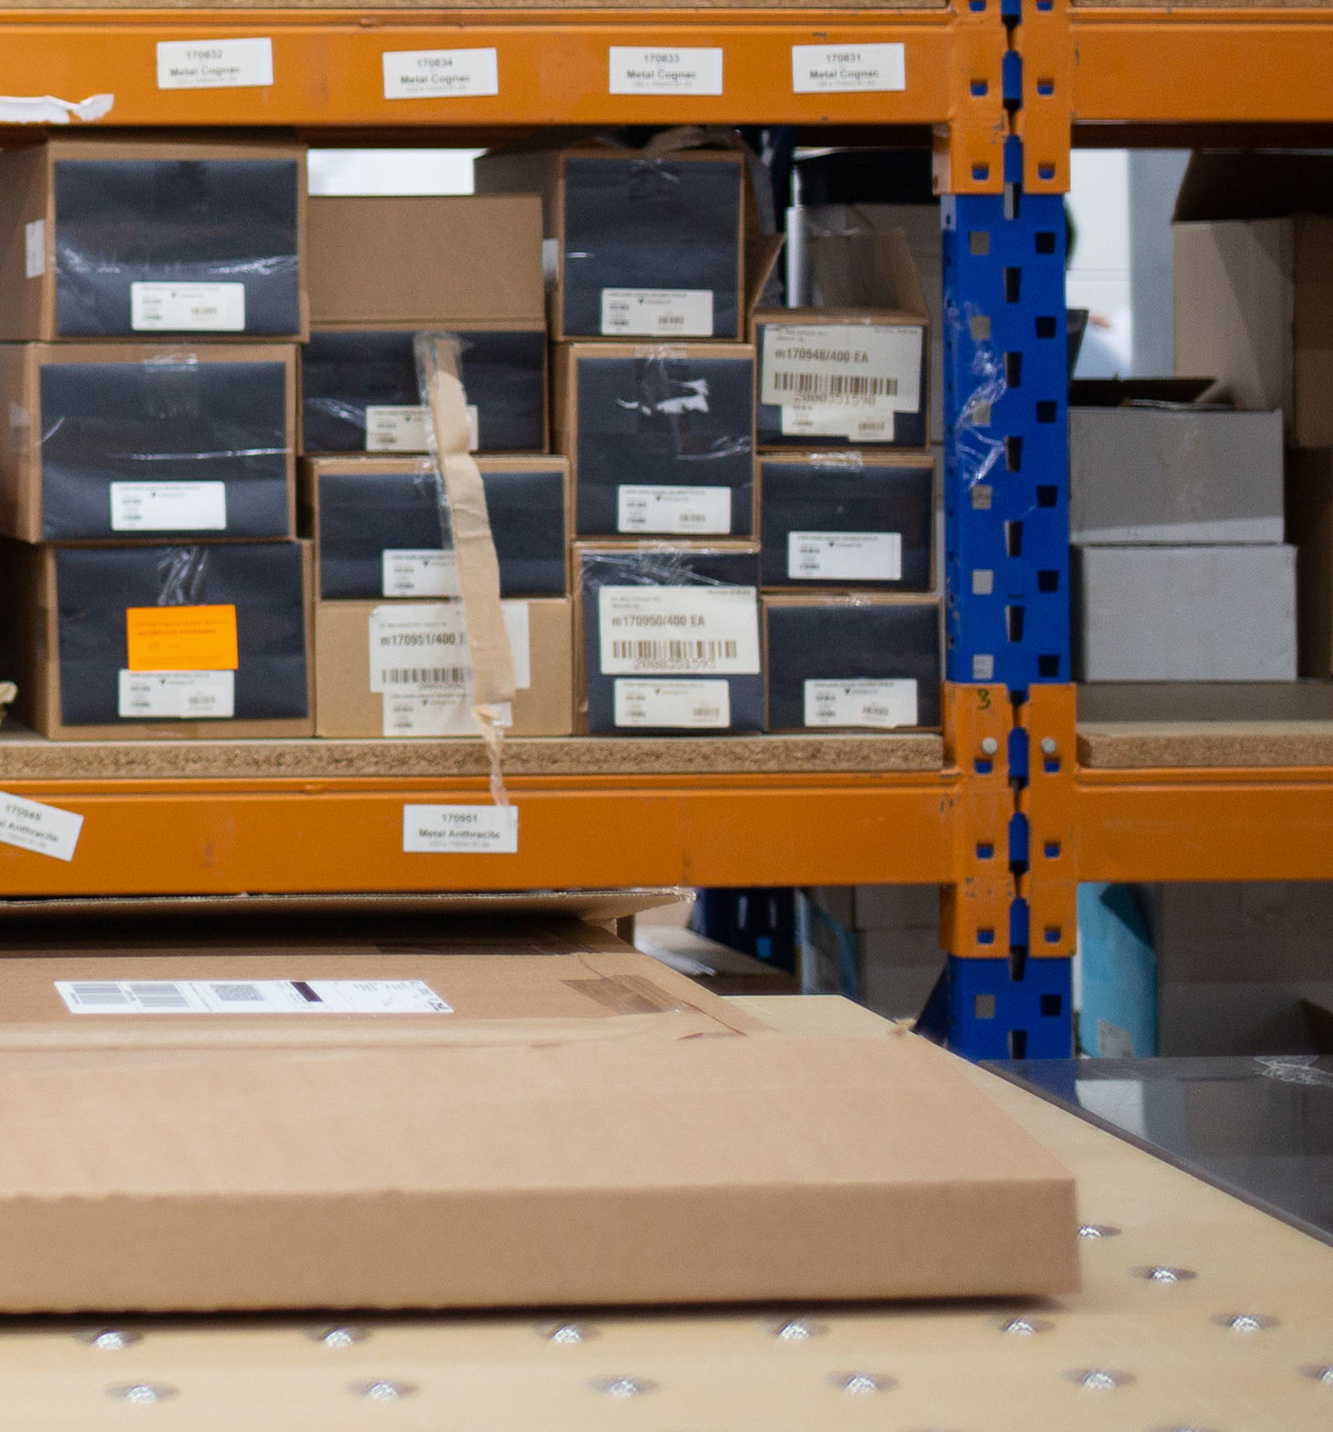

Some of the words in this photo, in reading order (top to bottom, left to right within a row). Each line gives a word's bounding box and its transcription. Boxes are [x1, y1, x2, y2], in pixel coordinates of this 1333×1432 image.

[169, 67, 199, 78] Metal
[201, 64, 240, 77] Cognac
[626, 69, 655, 79] Metal
[657, 68, 697, 81] Cognac
[809, 69, 838, 79] Metal
[839, 68, 879, 81] Cognac
[399, 74, 428, 84] Metal
[431, 73, 471, 85] Cognac
[853, 351, 869, 363] EA
[690, 614, 705, 627] EA
[419, 828, 446, 839] Metal
